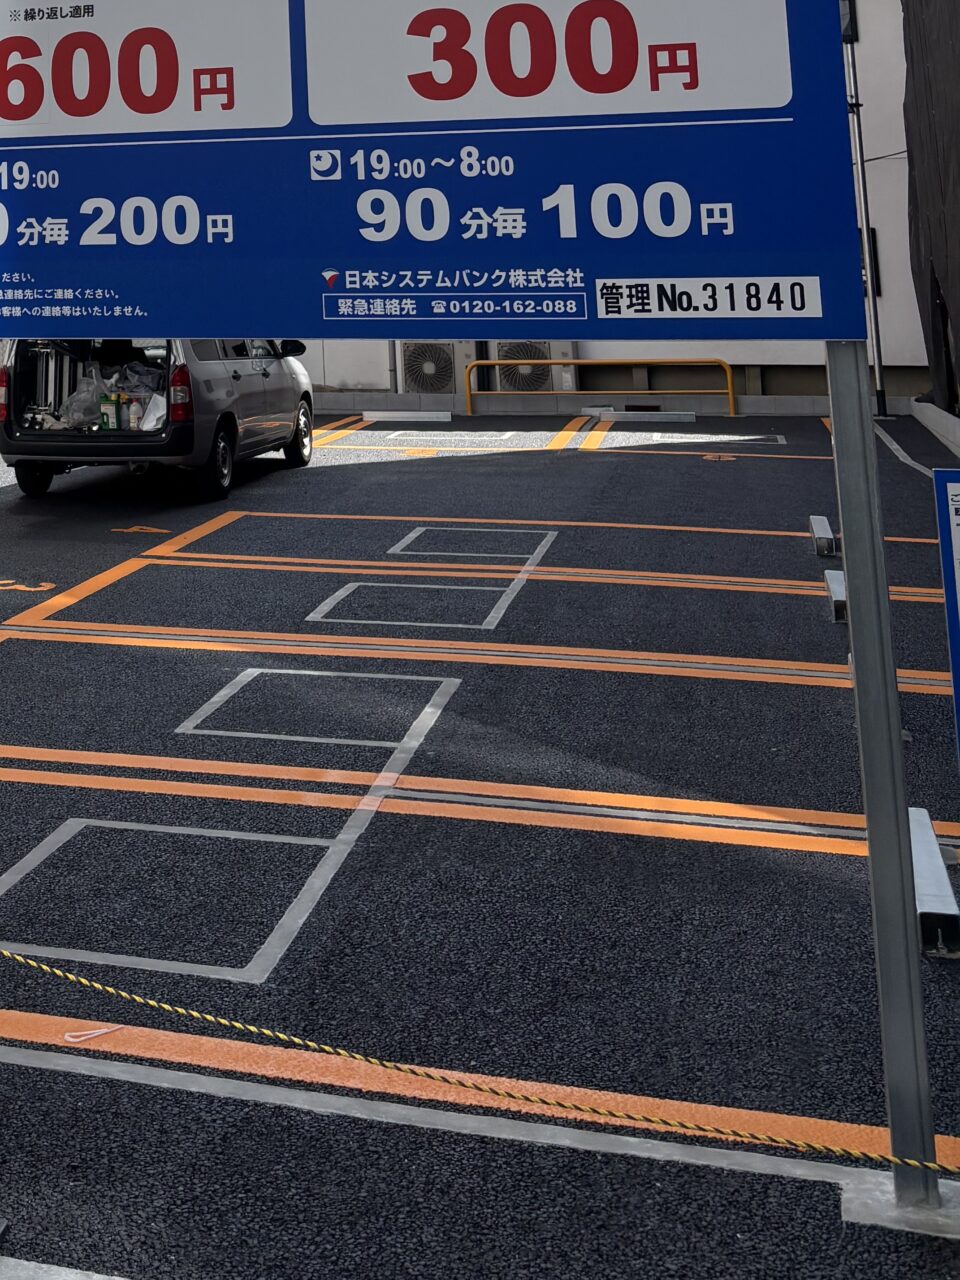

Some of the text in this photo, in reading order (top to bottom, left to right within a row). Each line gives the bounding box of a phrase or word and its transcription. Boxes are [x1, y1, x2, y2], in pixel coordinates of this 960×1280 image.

[344, 268, 585, 290] 日本システムバンク株式会社
[338, 298, 417, 315] 緊急連絡先
